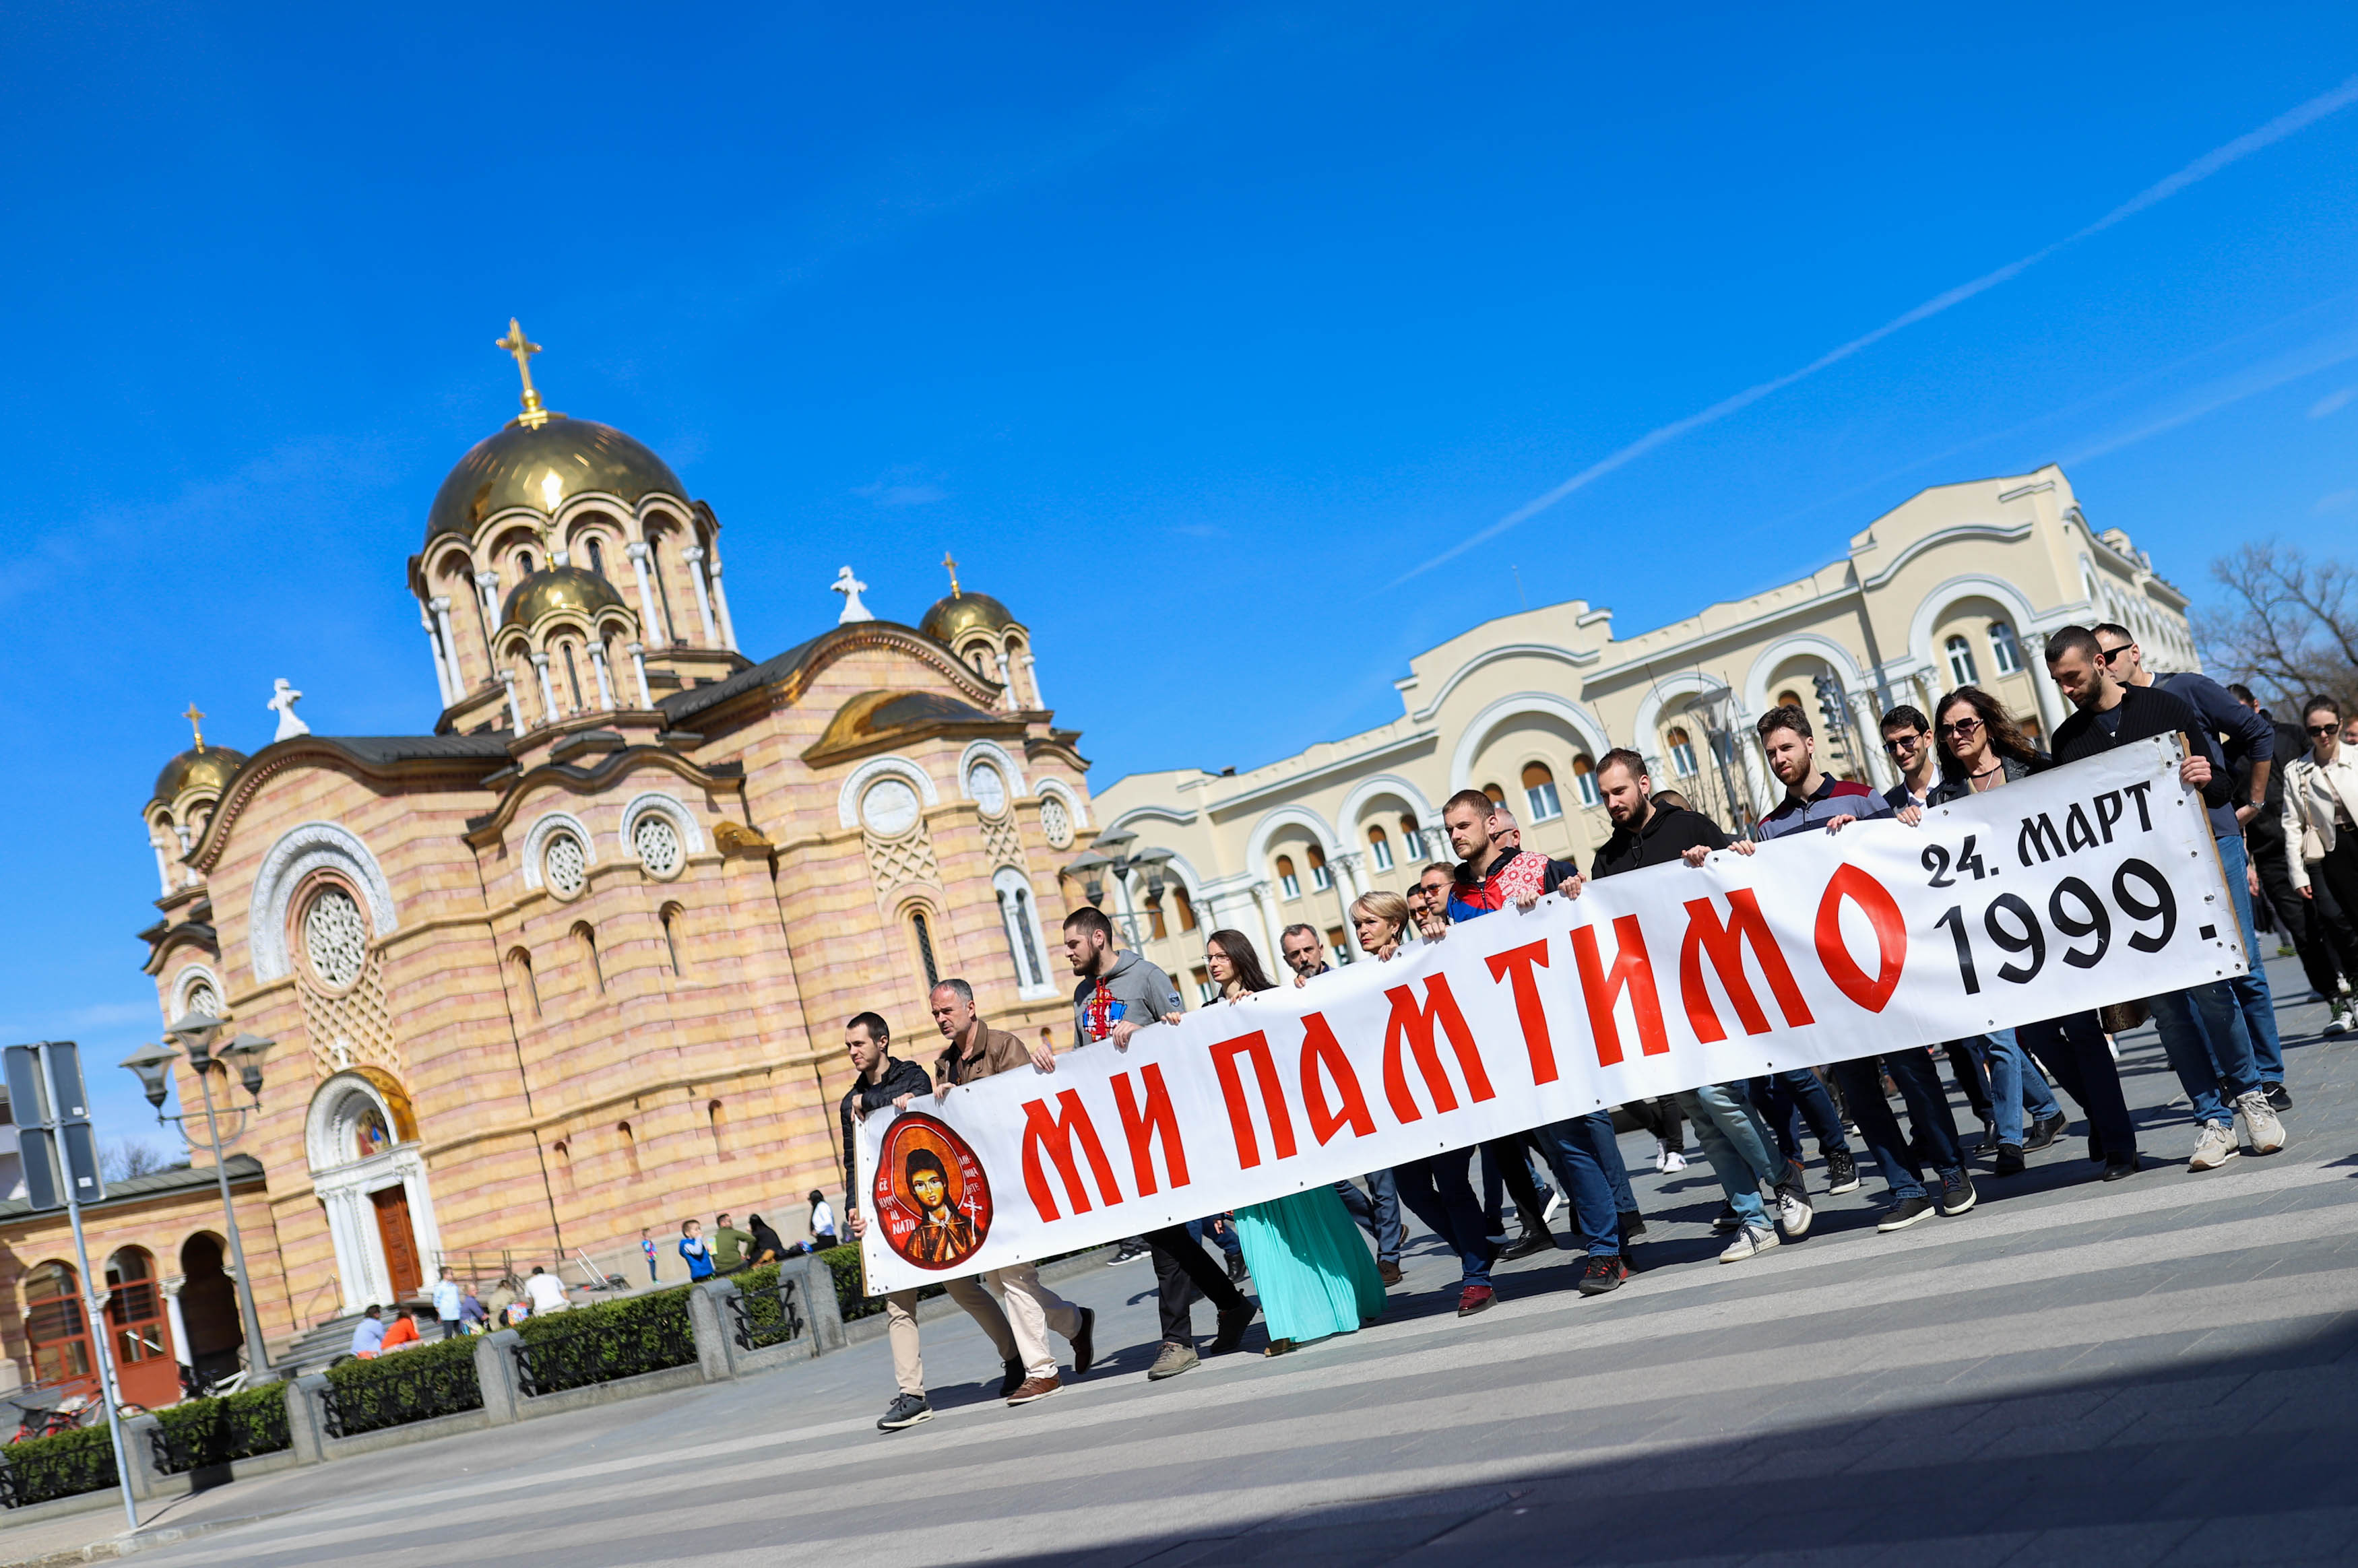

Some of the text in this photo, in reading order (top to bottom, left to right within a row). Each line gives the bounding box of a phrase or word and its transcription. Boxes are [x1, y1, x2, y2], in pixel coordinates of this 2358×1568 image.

[1921, 780, 2153, 888] 24. МАРТ
[1934, 858, 2217, 995] 1999.
[1021, 862, 1907, 1223] МИ ПАМТИМО
